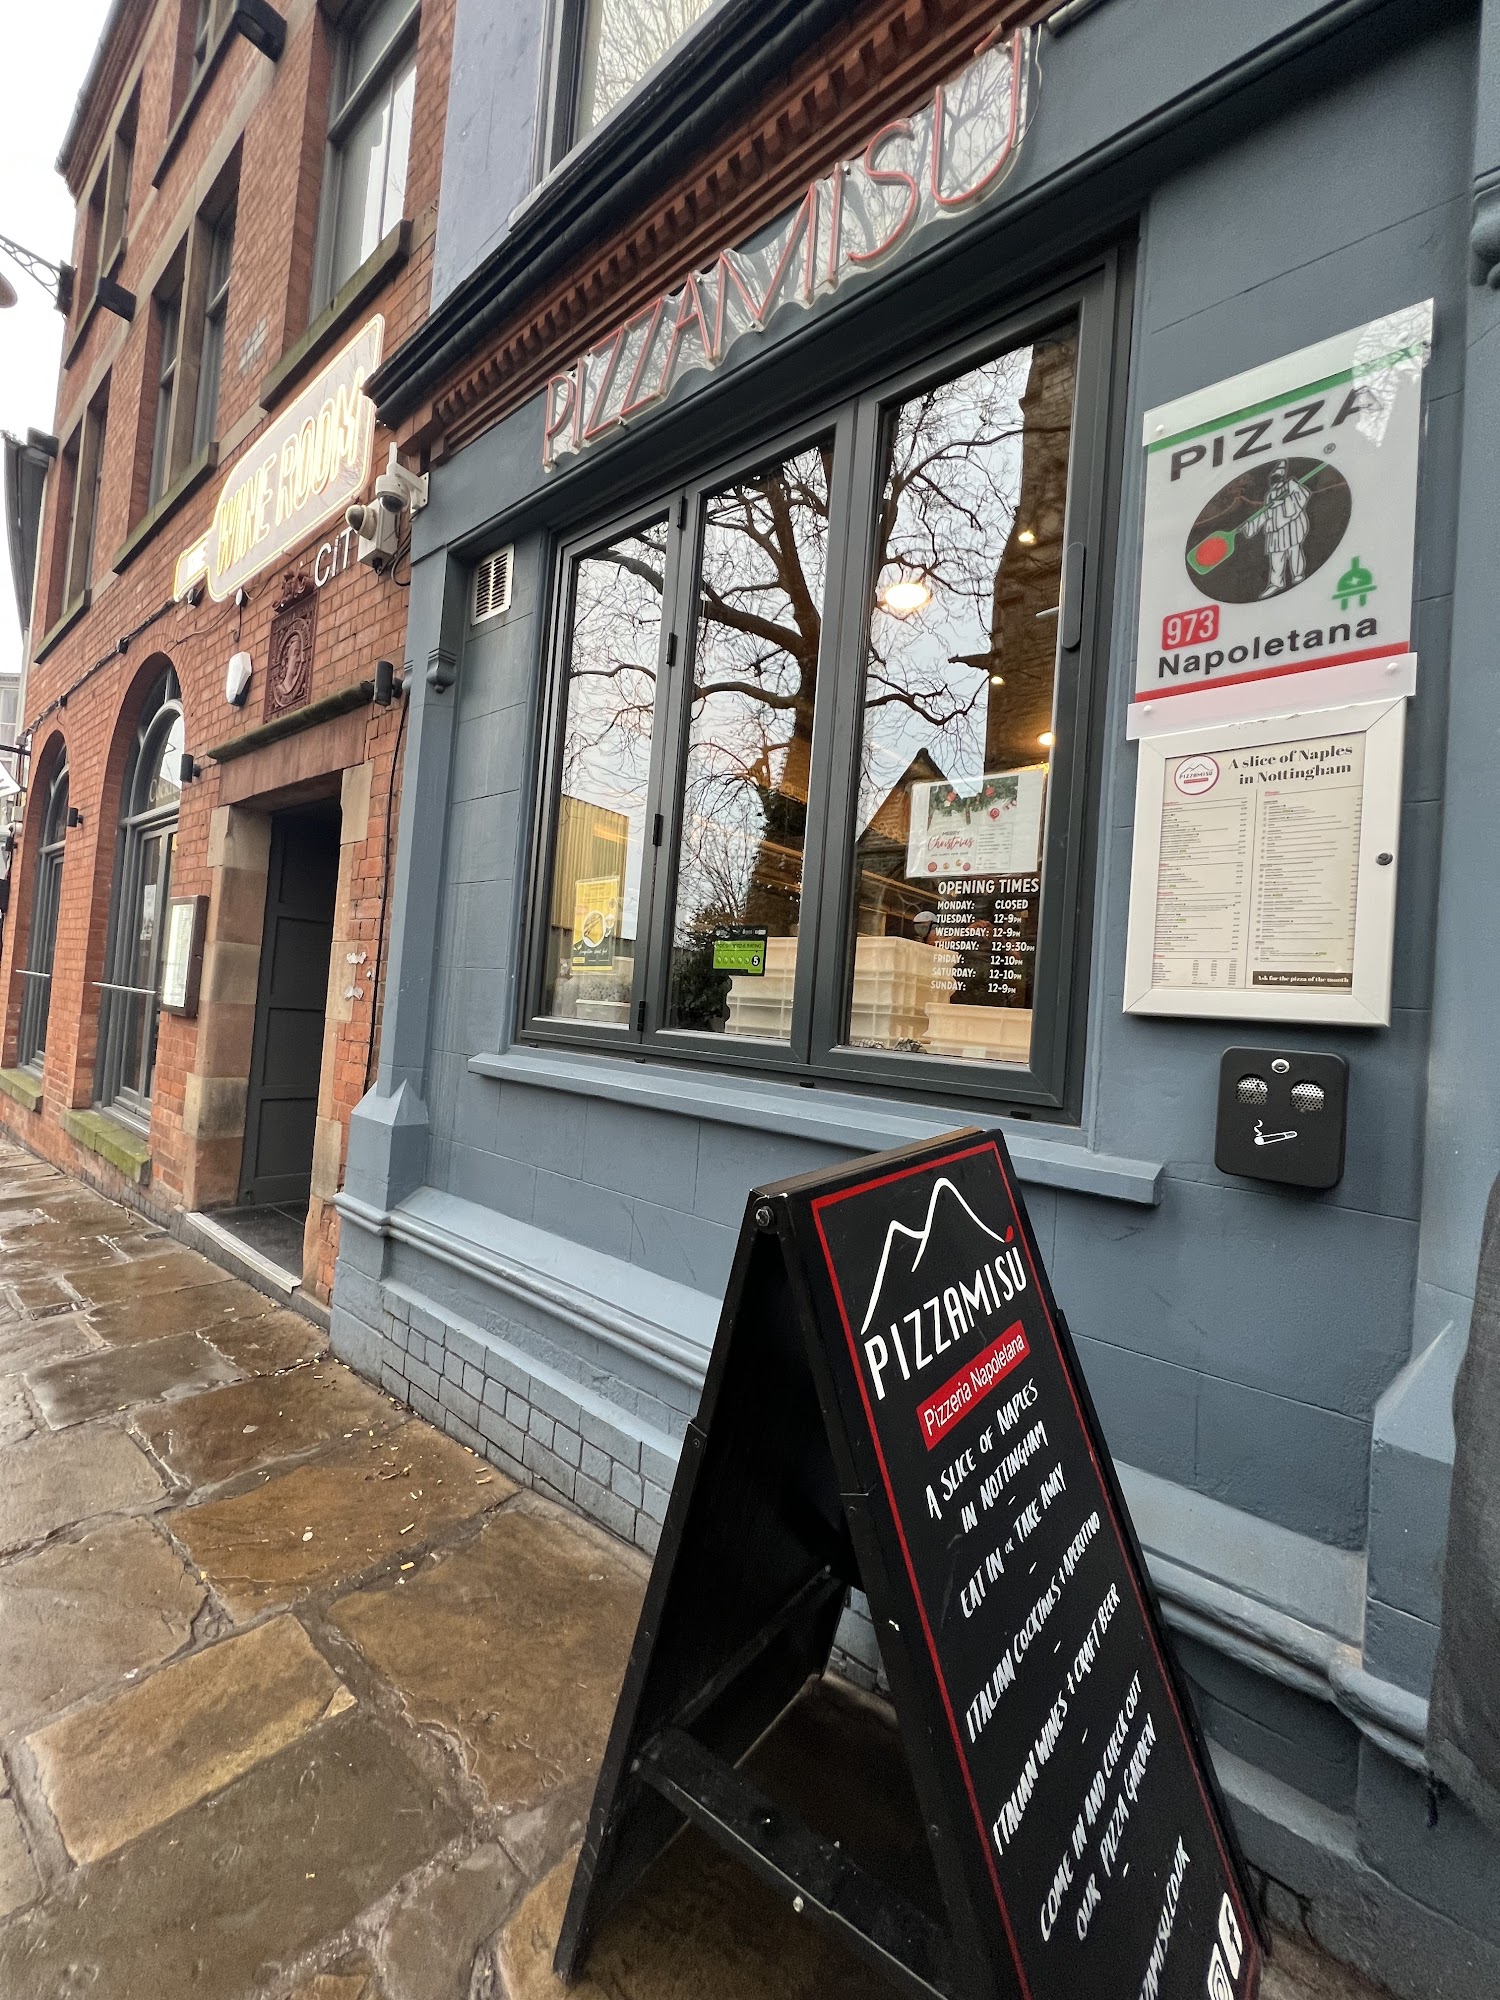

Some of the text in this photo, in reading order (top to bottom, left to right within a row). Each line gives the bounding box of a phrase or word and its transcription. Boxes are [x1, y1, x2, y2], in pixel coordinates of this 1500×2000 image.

[1170, 385, 1384, 482] PIZZA
[314, 525, 358, 587] CIT
[1166, 611, 1215, 646] 973
[1158, 616, 1377, 678] Napoletana
[1228, 745, 1353, 771] A slice of Naples
[1239, 764, 1351, 785] in Nottingham
[938, 878, 1040, 895] OPENING TIMES
[936, 913, 975, 923] TUESDAY:
[937, 899, 1029, 910] MONDAY: CLOSED
[934, 941, 979, 950] THURSDAY:
[935, 927, 989, 937] WEDNESDAY:
[752, 956, 759, 966] 5
[931, 967, 976, 978] SATURDAY:
[933, 954, 965, 963] FRIDAY:
[930, 980, 966, 991] SUNDAY:
[923, 1334, 1026, 1437] Pizzeria Napoletana
[925, 1377, 1038, 1520] A SLICE OF NAPLES
[960, 1420, 1049, 1534] IN NOTTINGHAM
[959, 1565, 986, 1619] EAT
[984, 1547, 1005, 1584] IN
[1012, 1498, 1043, 1543] TAKE
[1039, 1461, 1067, 1510] AWAY
[965, 1648, 1017, 1744] ITALIAN
[1012, 1575, 1062, 1664] COCKTAILS
[992, 1749, 1039, 1856] ITALIAN
[1034, 1689, 1068, 1766] WINES
[1074, 1618, 1101, 1683] CRAFT
[1097, 1582, 1120, 1634] BEER
[1040, 1669, 1142, 1942] COME IN AND CHECK OUT
[1076, 1712, 1156, 1942] OUR PIZZA GARDEN
